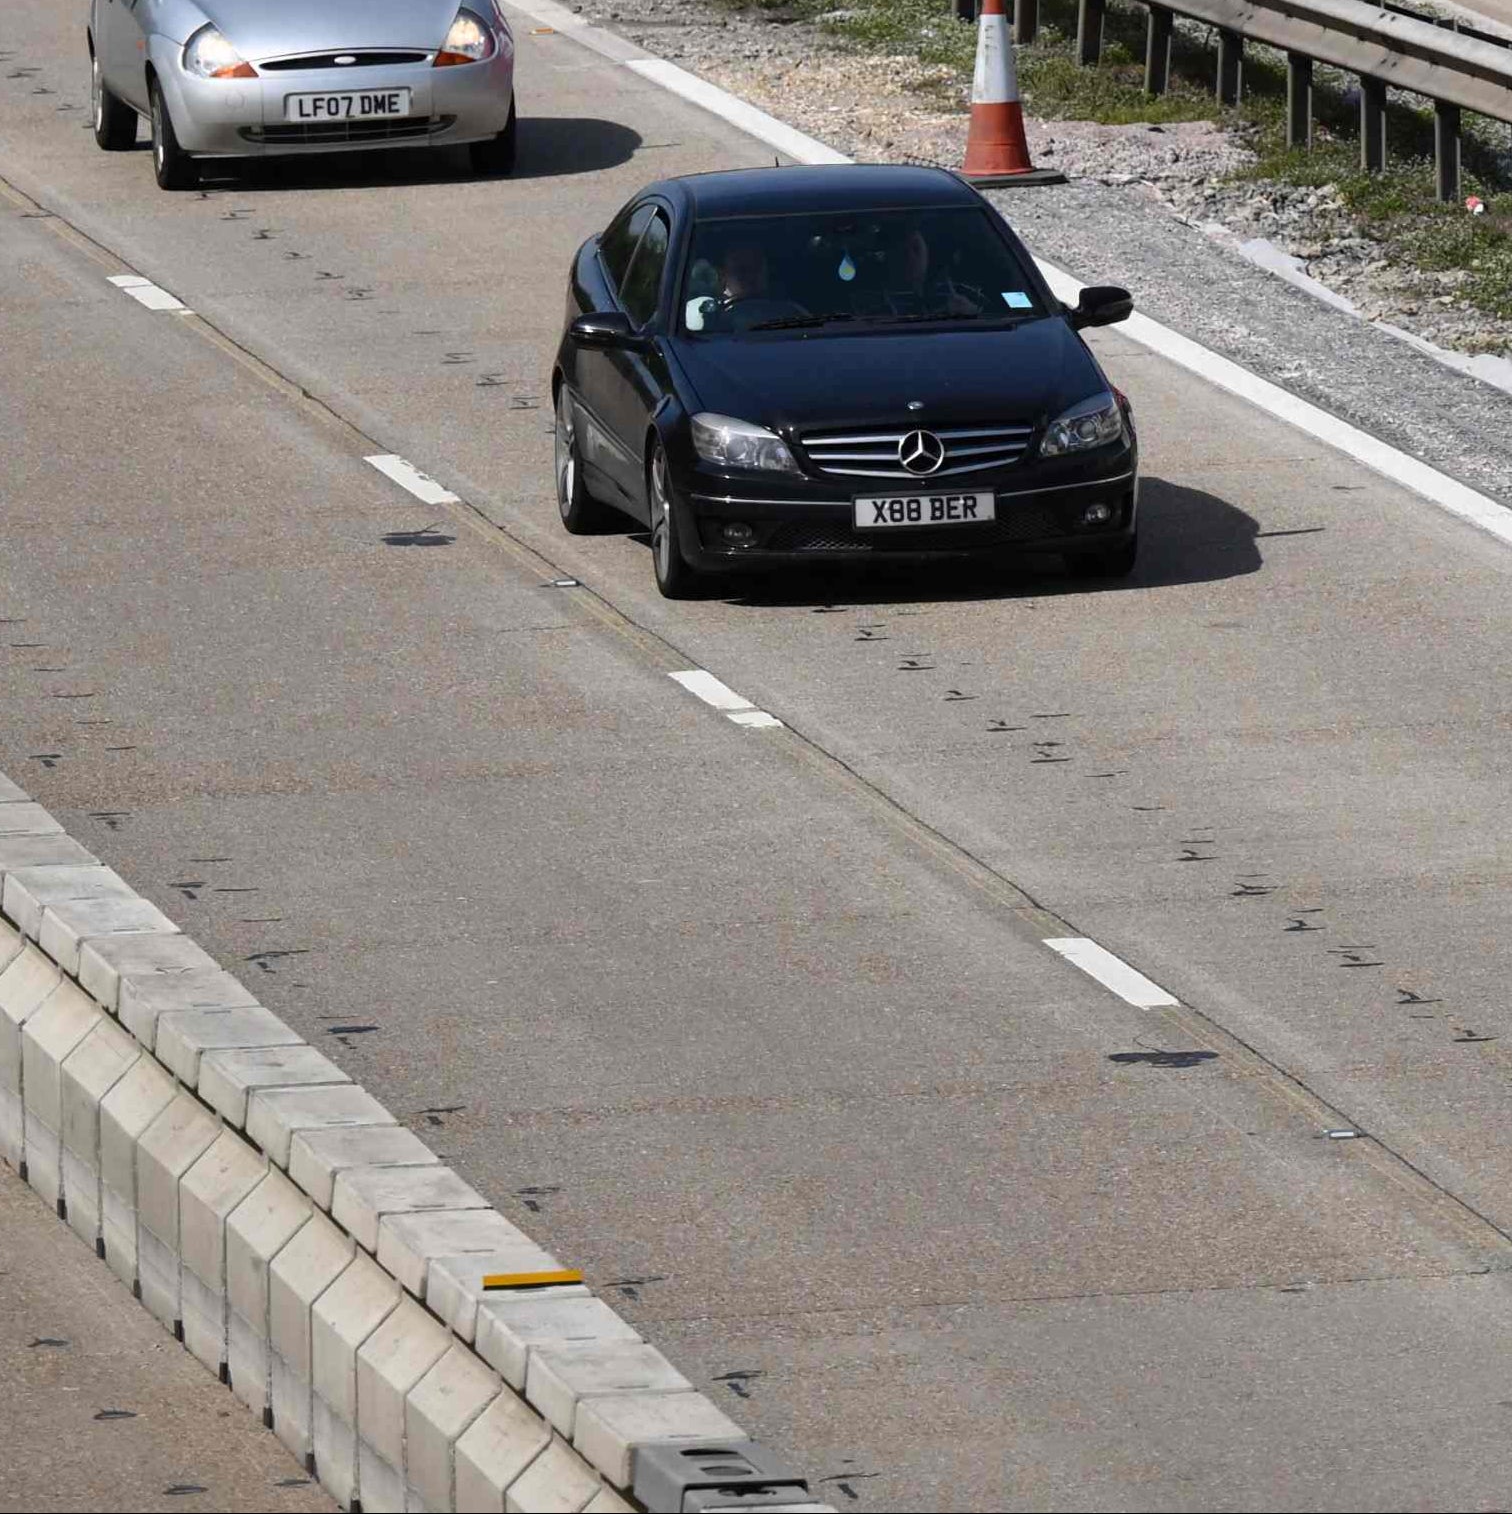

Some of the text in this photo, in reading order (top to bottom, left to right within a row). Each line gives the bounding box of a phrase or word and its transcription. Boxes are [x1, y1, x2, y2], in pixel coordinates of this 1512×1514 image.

[298, 93, 400, 118] LF07 DME
[871, 495, 978, 524] X88 BER
